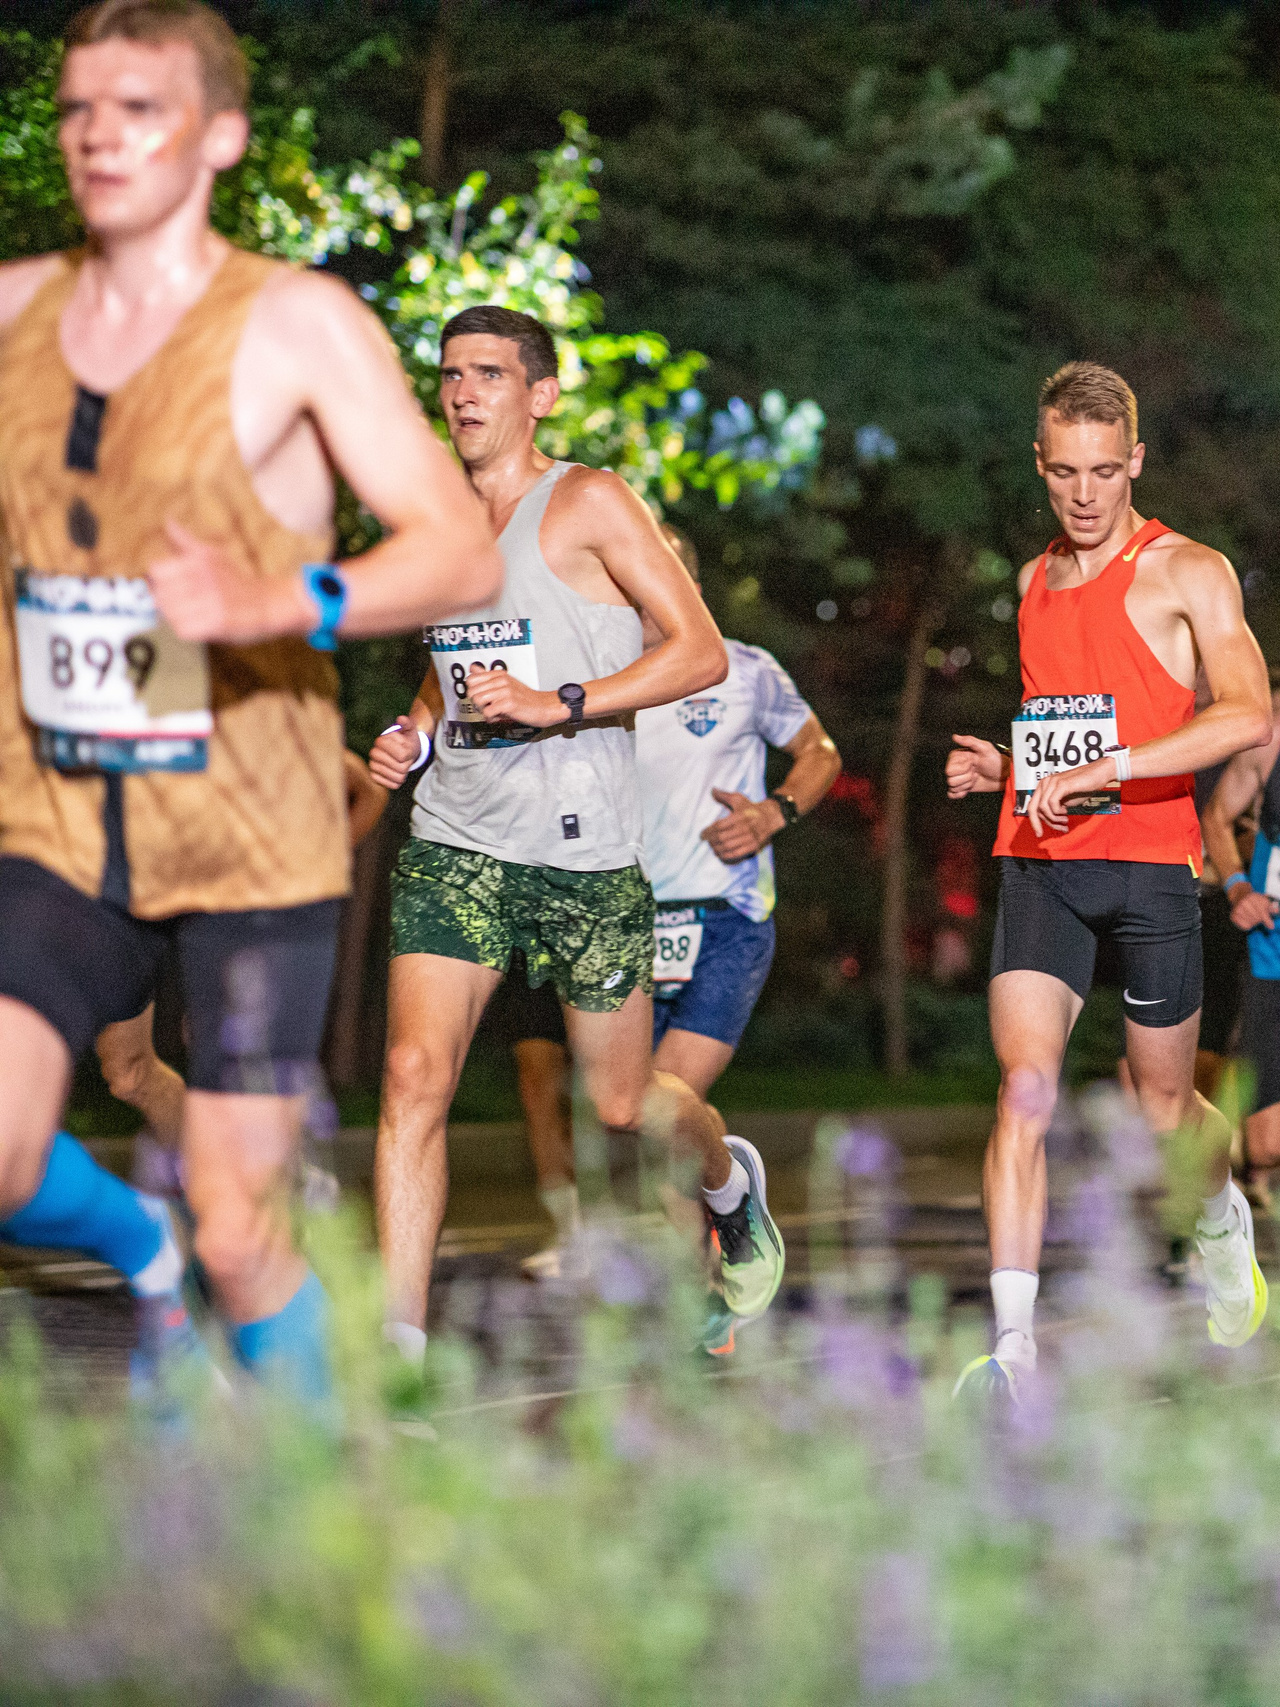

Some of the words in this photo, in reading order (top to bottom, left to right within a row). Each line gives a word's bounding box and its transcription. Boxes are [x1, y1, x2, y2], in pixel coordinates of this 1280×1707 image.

[49, 634, 157, 690] 899
[1025, 730, 1104, 767] 3468
[655, 935, 690, 961] 88
